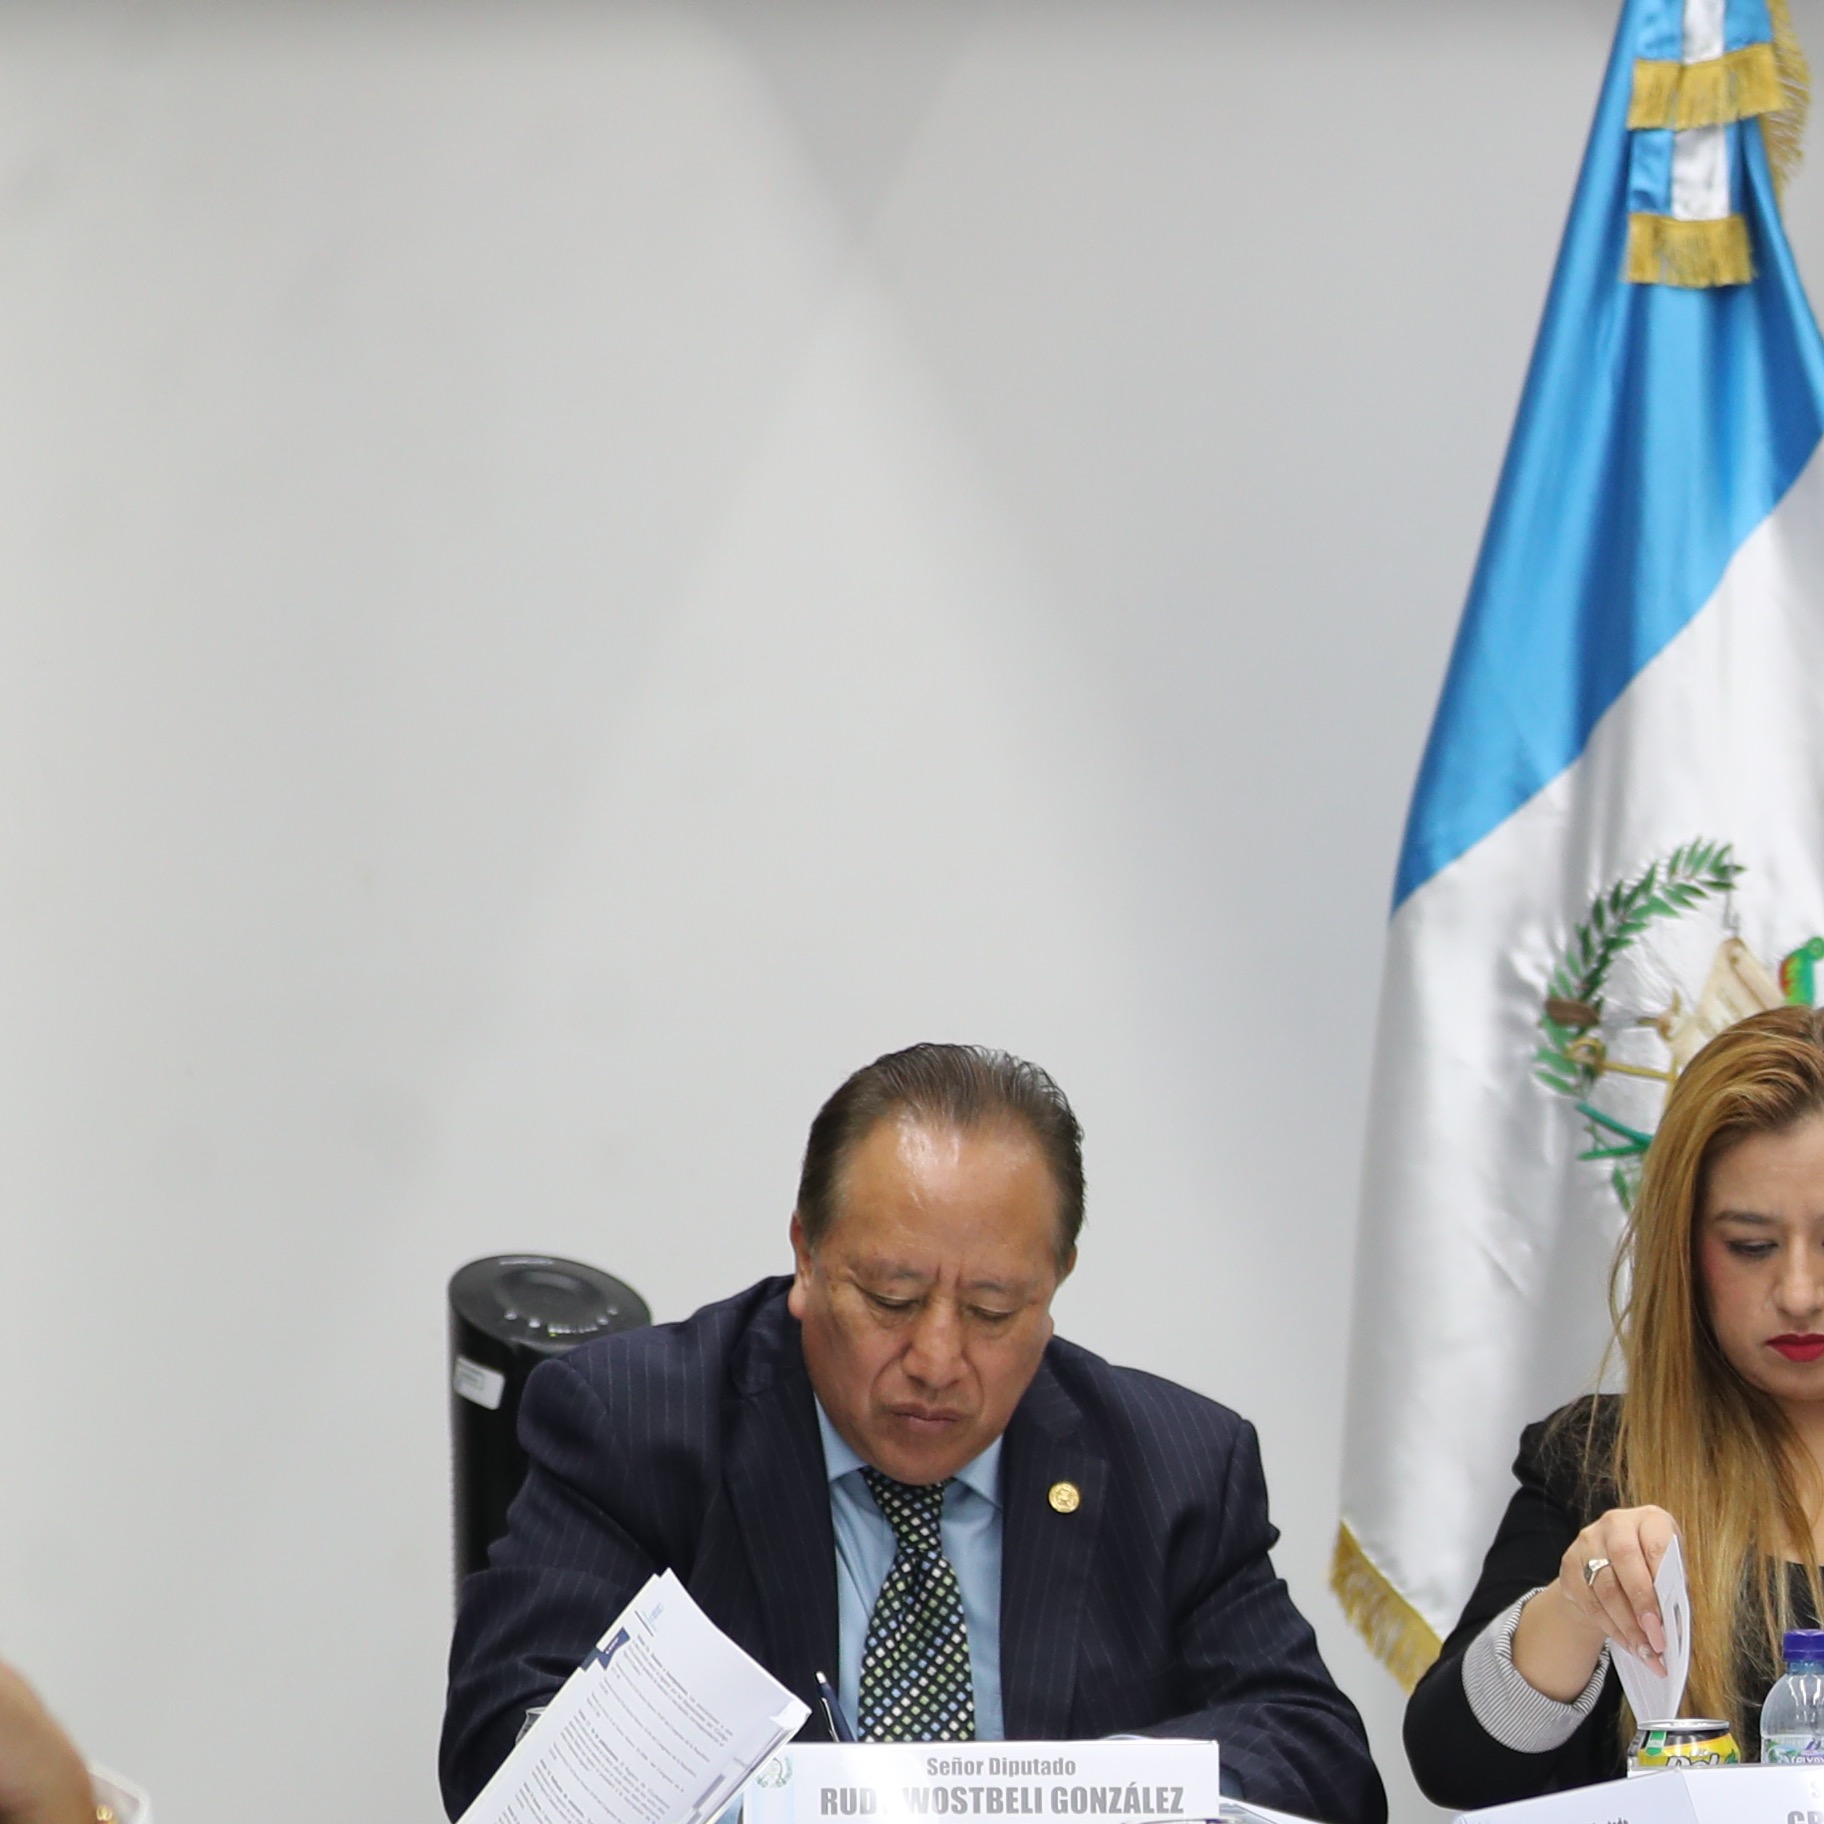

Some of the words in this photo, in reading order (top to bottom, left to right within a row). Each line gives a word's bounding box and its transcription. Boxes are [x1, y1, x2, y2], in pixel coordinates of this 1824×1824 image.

[927, 1757, 983, 1777] Señor
[989, 1757, 1076, 1778] Diputado
[821, 1787, 888, 1815] RUD
[1051, 1782, 1184, 1815] GONZÁLEZ
